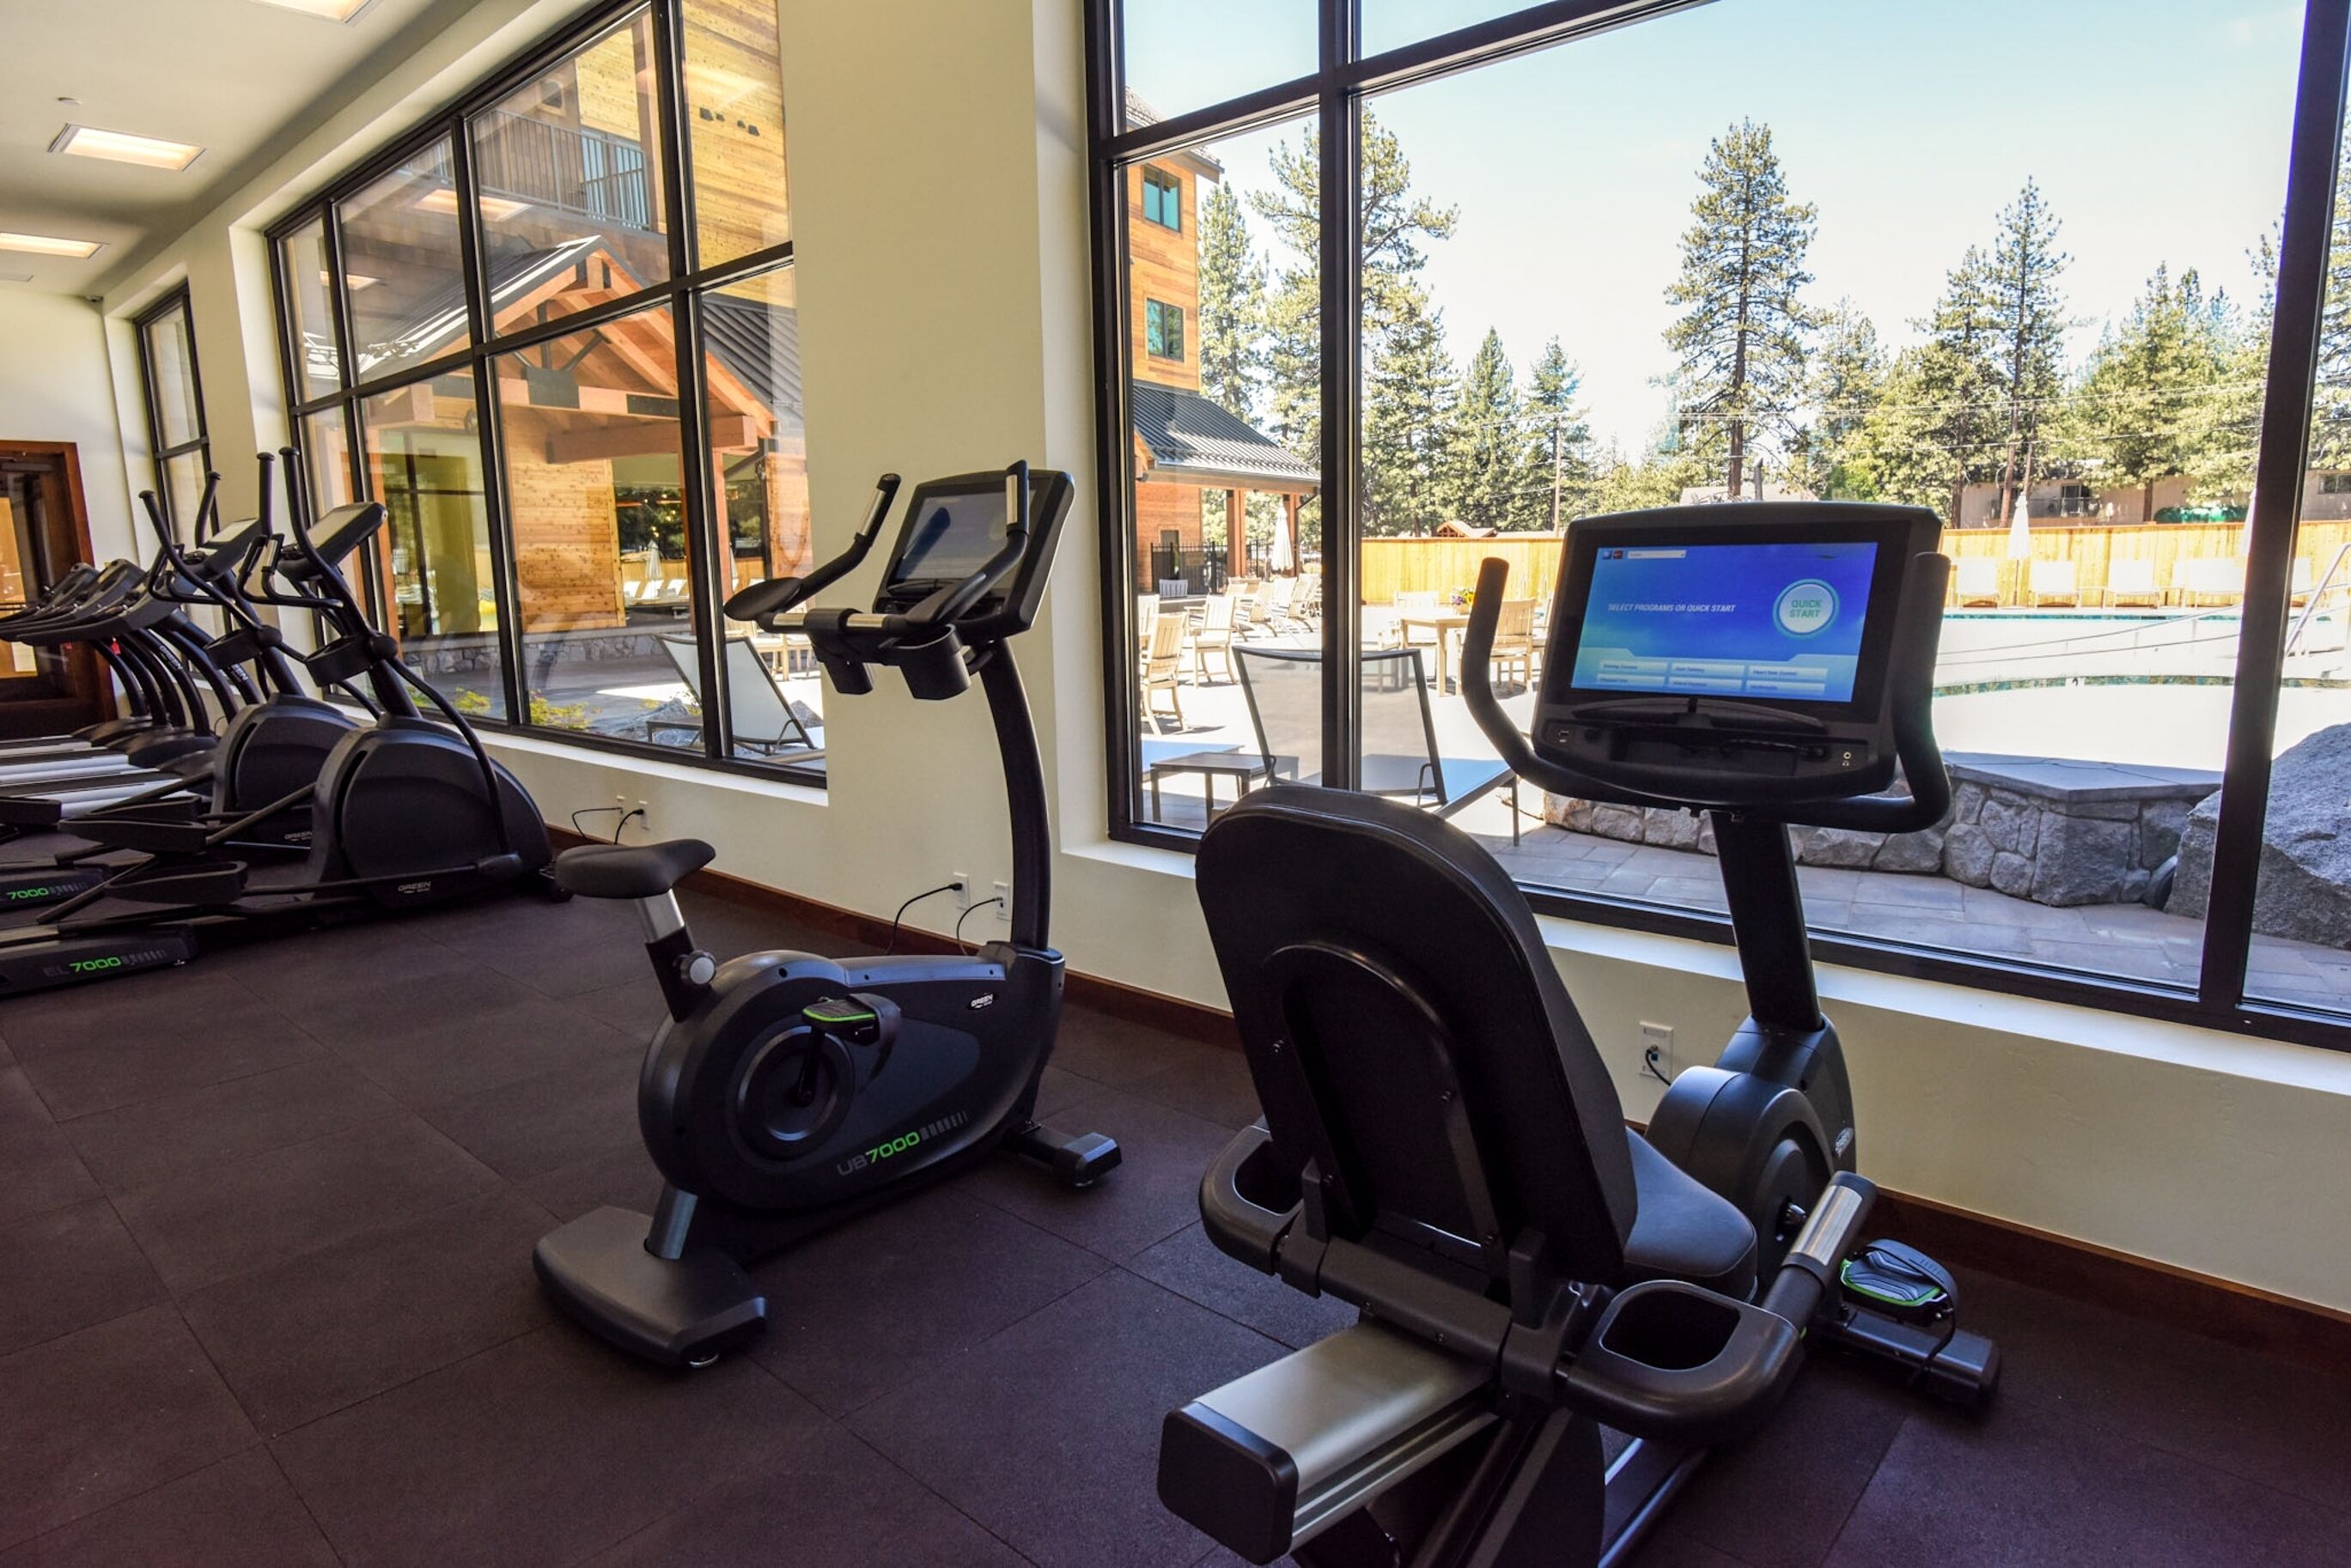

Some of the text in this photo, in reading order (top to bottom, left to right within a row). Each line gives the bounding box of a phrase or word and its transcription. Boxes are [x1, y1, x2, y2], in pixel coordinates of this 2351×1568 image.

[1686, 604, 1709, 612] QUICK
[1711, 604, 1736, 612] START
[1791, 599, 1822, 608] QUICK
[1789, 609, 1820, 617] START
[159, 645, 183, 670] GREEN
[837, 1131, 921, 1176] UB7000
